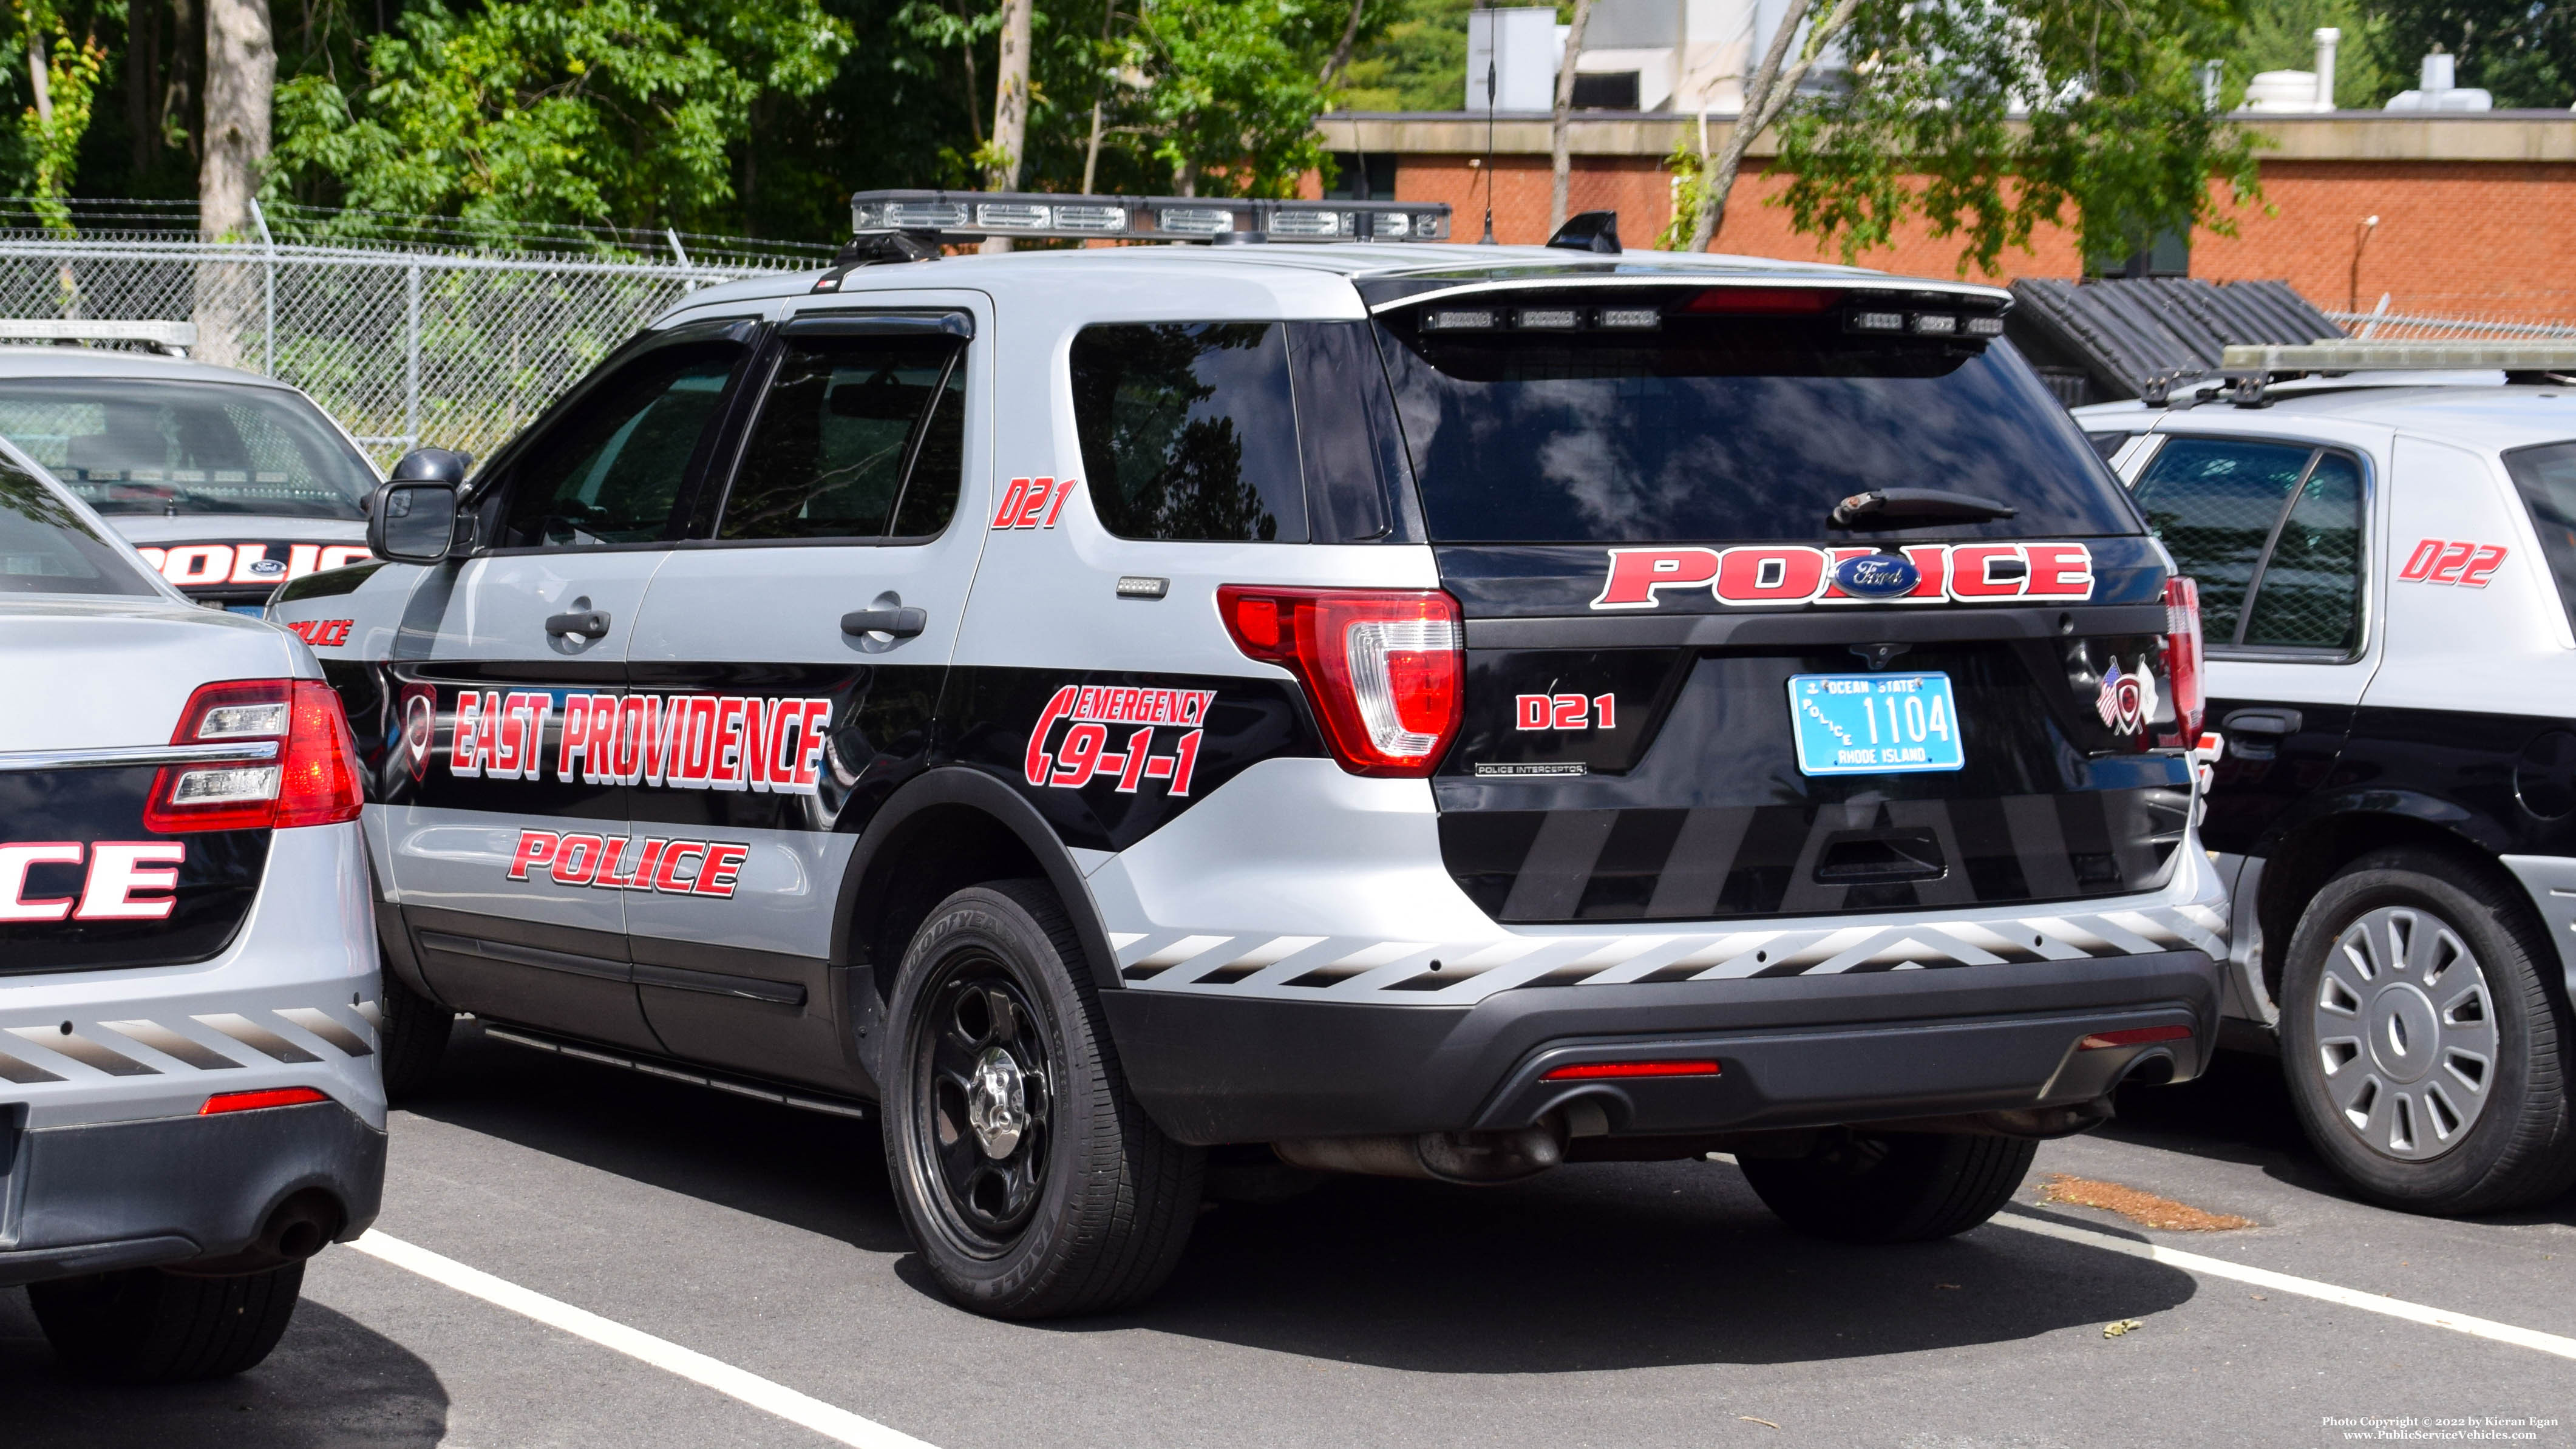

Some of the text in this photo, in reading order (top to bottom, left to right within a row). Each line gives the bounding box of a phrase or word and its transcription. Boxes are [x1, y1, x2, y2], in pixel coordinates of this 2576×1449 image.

[991, 476, 1078, 529] D21
[1854, 560, 1903, 585] Ford
[2397, 537, 2510, 588] D22
[1069, 685, 1217, 727] EMERGENCY
[1516, 693, 1616, 730] D21
[1828, 680, 1916, 694] OCEAN STATE
[450, 691, 552, 781] EAST
[557, 694, 834, 795] PROVIDENCE
[1803, 698, 1852, 746] POLICE
[1864, 694, 1948, 744] 1104
[1049, 723, 1203, 796] 9-1-1
[1838, 747, 1926, 764] RHODE ISLAND
[505, 828, 750, 898] POLICE
